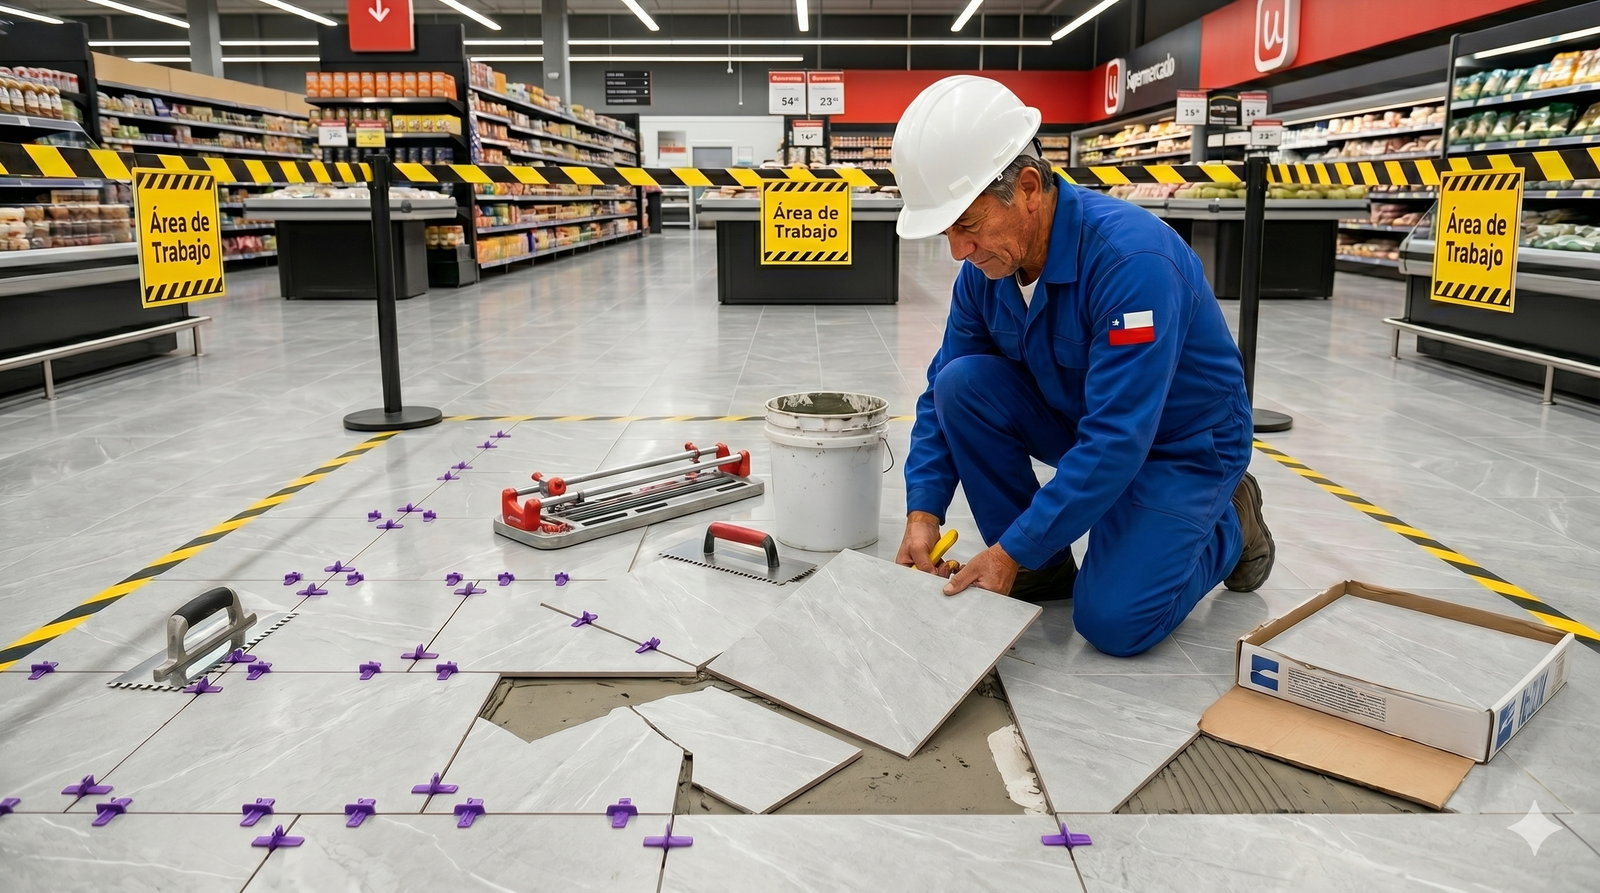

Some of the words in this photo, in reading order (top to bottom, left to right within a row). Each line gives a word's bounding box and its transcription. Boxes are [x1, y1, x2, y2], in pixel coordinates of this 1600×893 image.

[1126, 52, 1175, 93] Supermercado
[150, 205, 187, 234] Área
[191, 211, 210, 232] de
[773, 201, 812, 220] Área
[818, 205, 839, 220] de
[1446, 206, 1481, 235] Área
[1486, 212, 1507, 236] de
[774, 223, 838, 242] Trabajo
[151, 238, 211, 266] Trabajo
[1446, 240, 1503, 271] Trabajo
